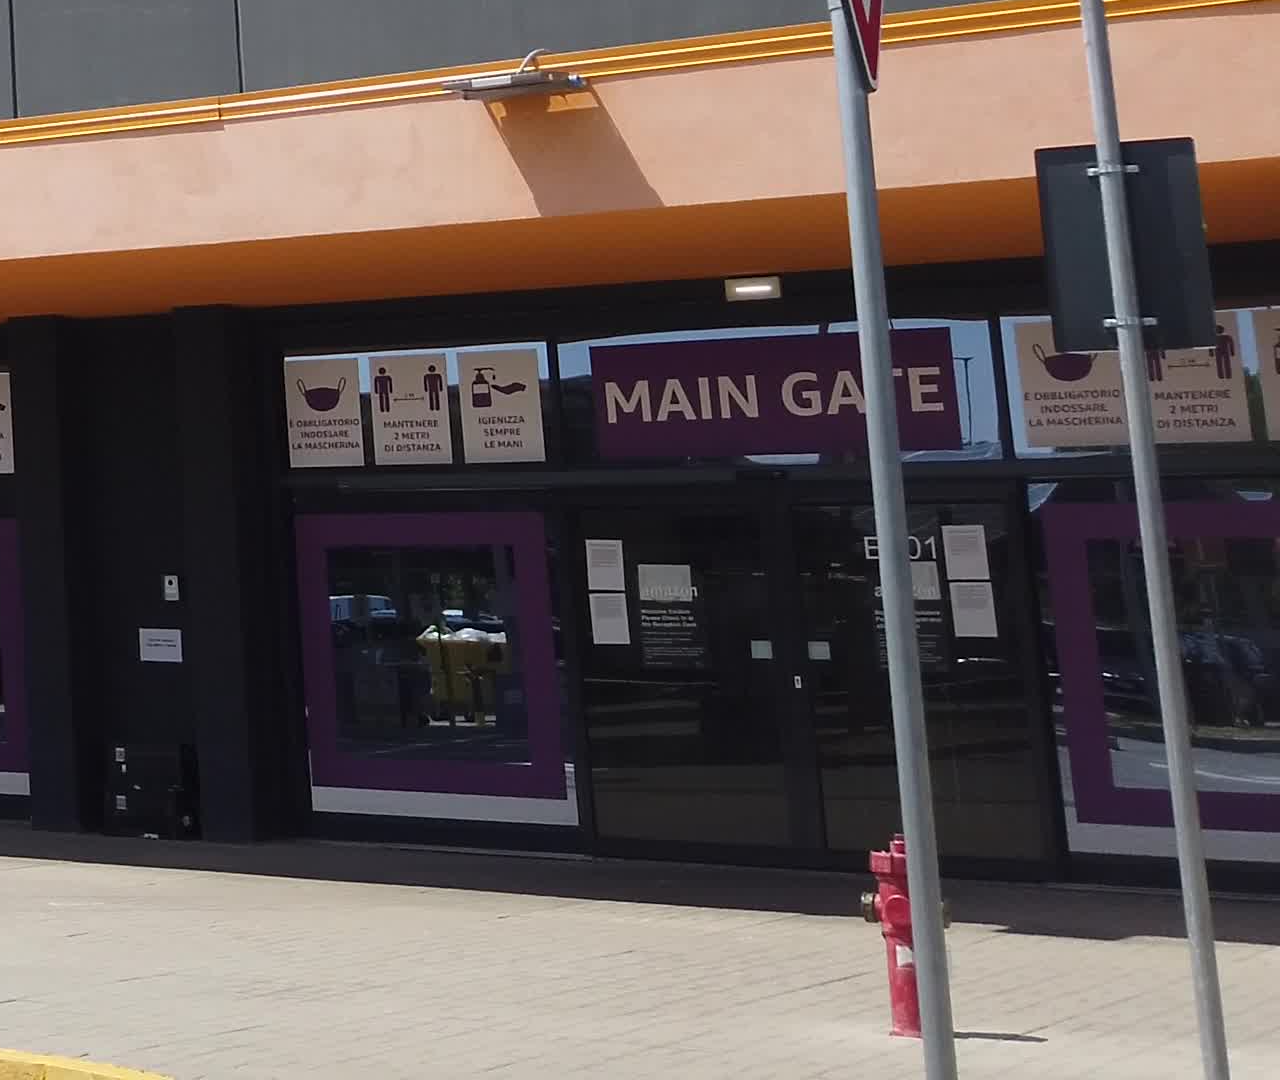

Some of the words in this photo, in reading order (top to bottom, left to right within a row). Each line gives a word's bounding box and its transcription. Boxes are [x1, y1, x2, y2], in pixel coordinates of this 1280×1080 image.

[604, 374, 759, 424] MAIN
[781, 366, 944, 417] GAE
[1034, 389, 1120, 401] OBBLIGATORIO
[1154, 389, 1231, 400] MANTENERE
[1041, 403, 1109, 414] INDOSSARE
[1180, 404, 1218, 413] METRI
[297, 418, 360, 428] OBBLIGATORIO
[478, 415, 525, 424] IGIENIZZA
[1029, 418, 1044, 427] LA
[1046, 416, 1124, 426] MASCHERINA
[1174, 417, 1236, 428] DISTANZA
[384, 420, 439, 429] MANTENERE
[301, 430, 350, 439] INDOSSARE
[402, 431, 430, 439] METRI
[483, 428, 521, 436] SEMPRE
[305, 441, 360, 449] MASCHERINA
[397, 443, 441, 452] DISTANZA
[484, 440, 495, 448] LE
[498, 440, 523, 448] MANI
[864, 536, 936, 559] E01
